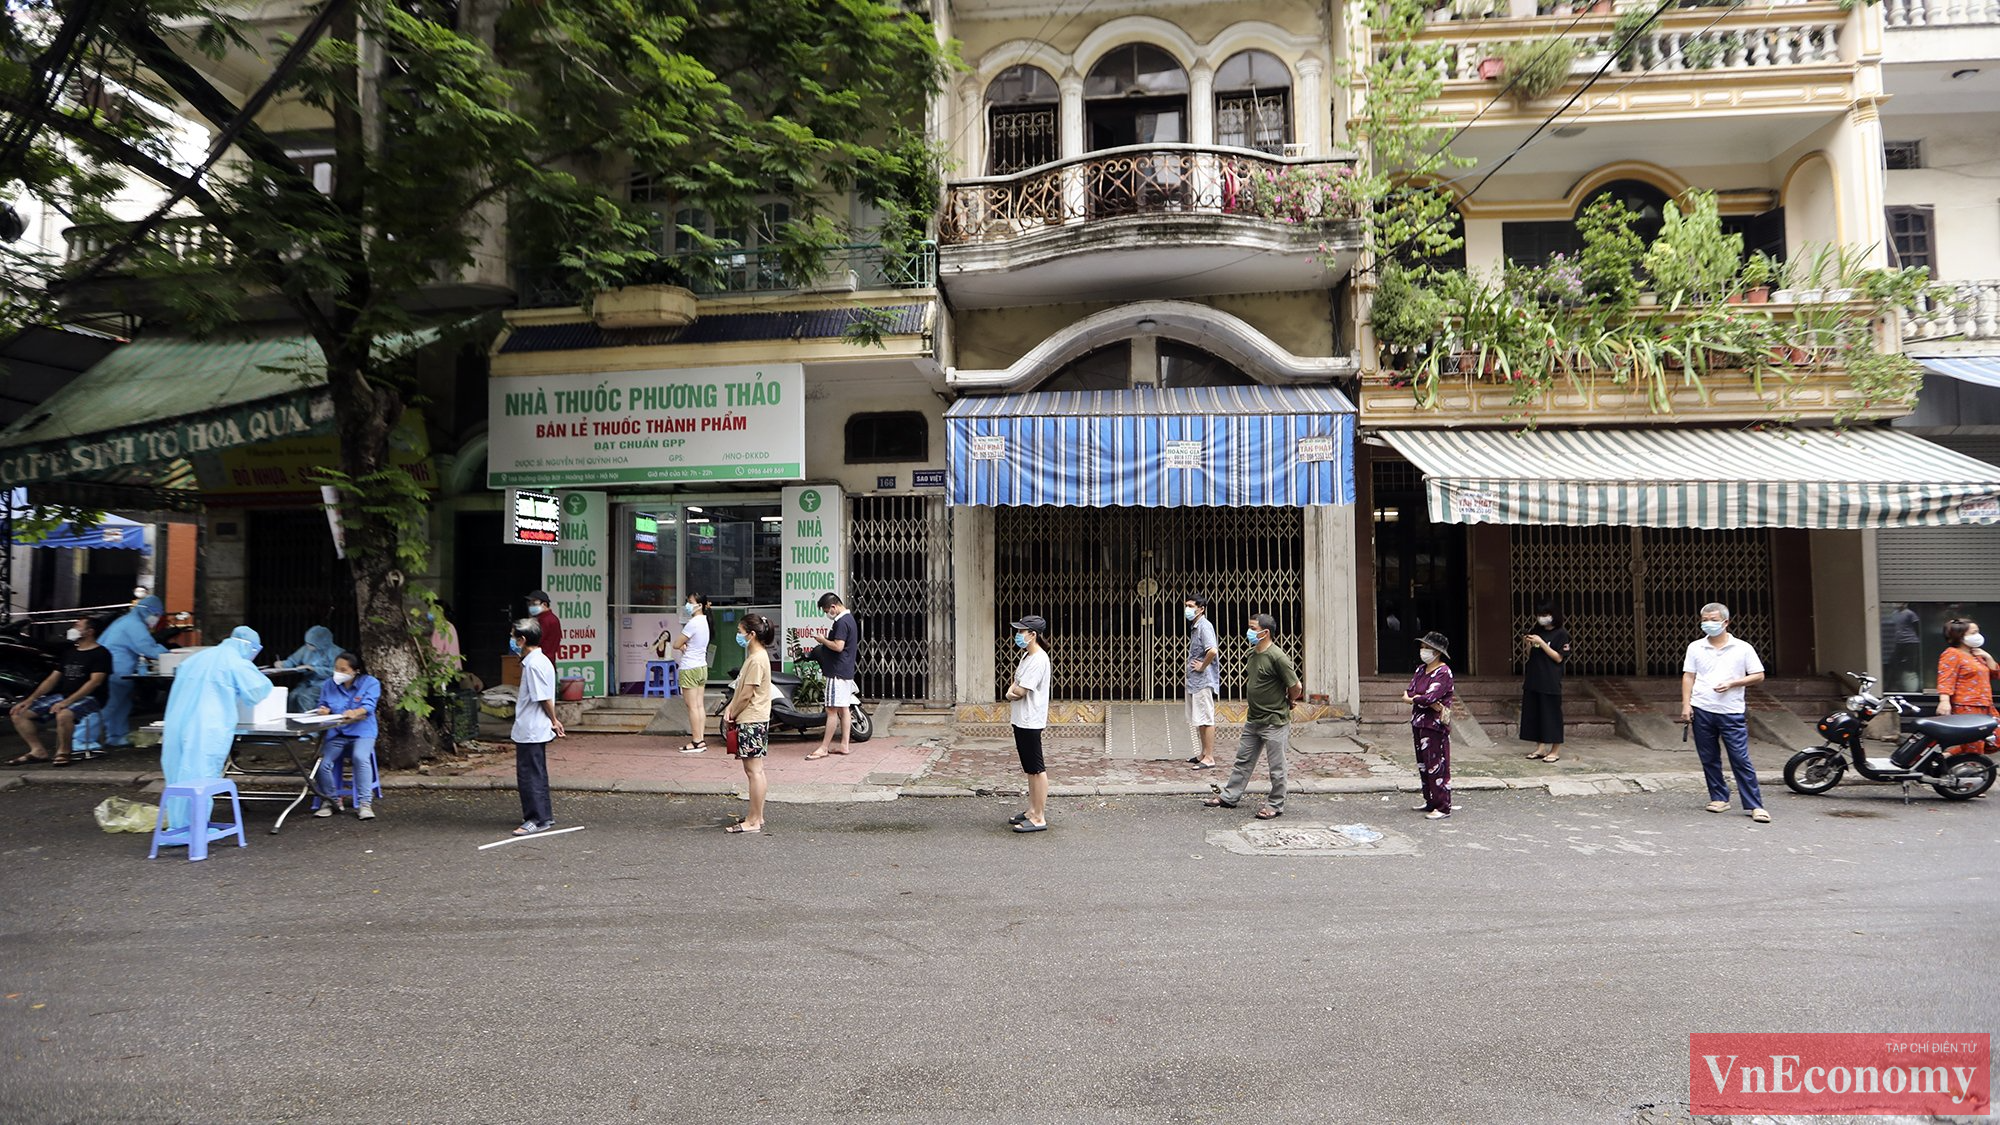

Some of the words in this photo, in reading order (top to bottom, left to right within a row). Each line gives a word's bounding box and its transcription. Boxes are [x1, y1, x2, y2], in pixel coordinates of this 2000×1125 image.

[505, 387, 547, 416] NHÀ
[554, 380, 621, 414] THUỐC
[629, 383, 717, 411] PHƯƠNG
[724, 372, 781, 407] THẢO
[536, 421, 566, 438] BÁN
[572, 416, 588, 437] LẺ
[593, 416, 640, 436] THUỐC
[646, 416, 696, 434] THÀNH
[701, 410, 746, 432] PHẨM
[70, 437, 136, 472] SINH
[594, 441, 616, 452] ĐẠT
[662, 439, 686, 448] GPP
[880, 478, 894, 487] 166
[561, 520, 588, 540] NHÀ
[798, 516, 822, 538] NHÀ
[553, 544, 596, 567] THUỐC
[790, 540, 830, 564] THUỐC
[546, 573, 602, 592] PHƯƠNG
[786, 571, 834, 590] PHƯƠNG
[557, 594, 592, 619] THẢO
[570, 624, 596, 639] CHUẨN
[557, 644, 592, 660] GPP
